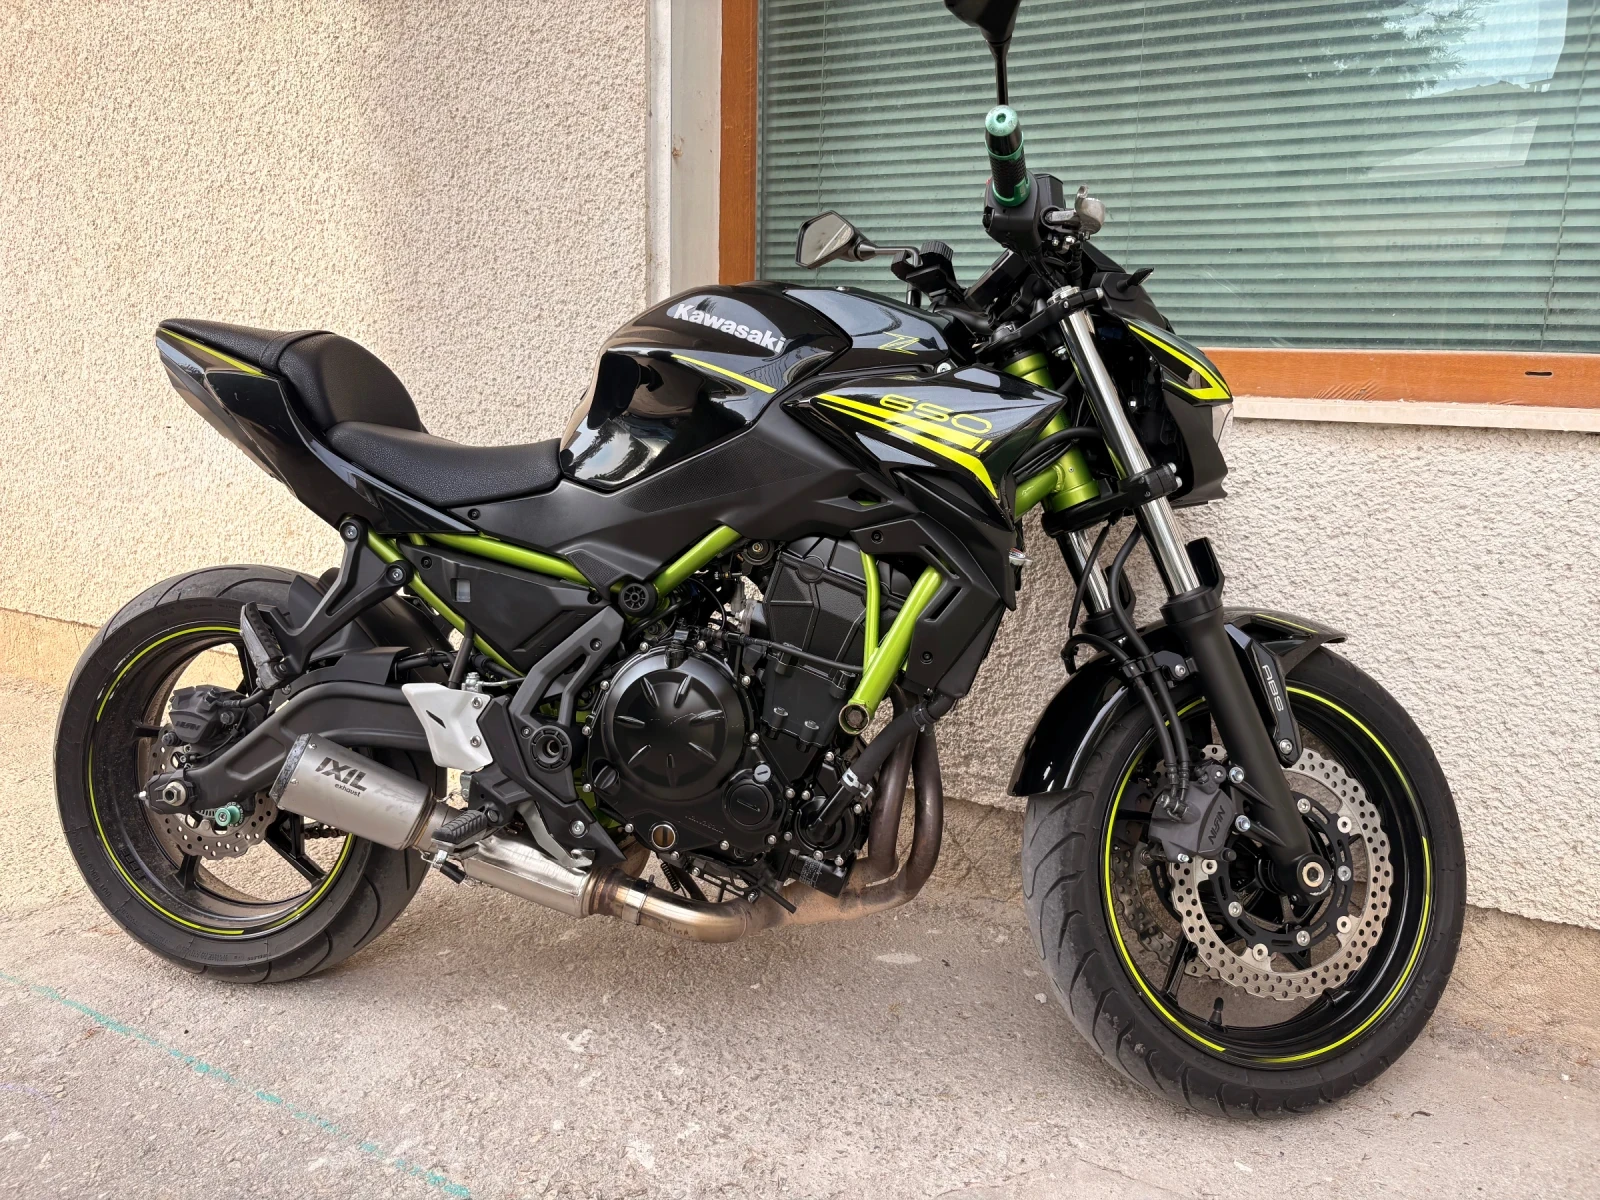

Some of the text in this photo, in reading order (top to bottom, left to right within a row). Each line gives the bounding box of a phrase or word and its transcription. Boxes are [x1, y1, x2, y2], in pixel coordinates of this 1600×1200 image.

[673, 303, 786, 354] Kawasaki
[880, 393, 993, 435] 650
[1262, 664, 1285, 712] ABS
[316, 757, 367, 791] IXIL
[335, 784, 361, 797] exhaust
